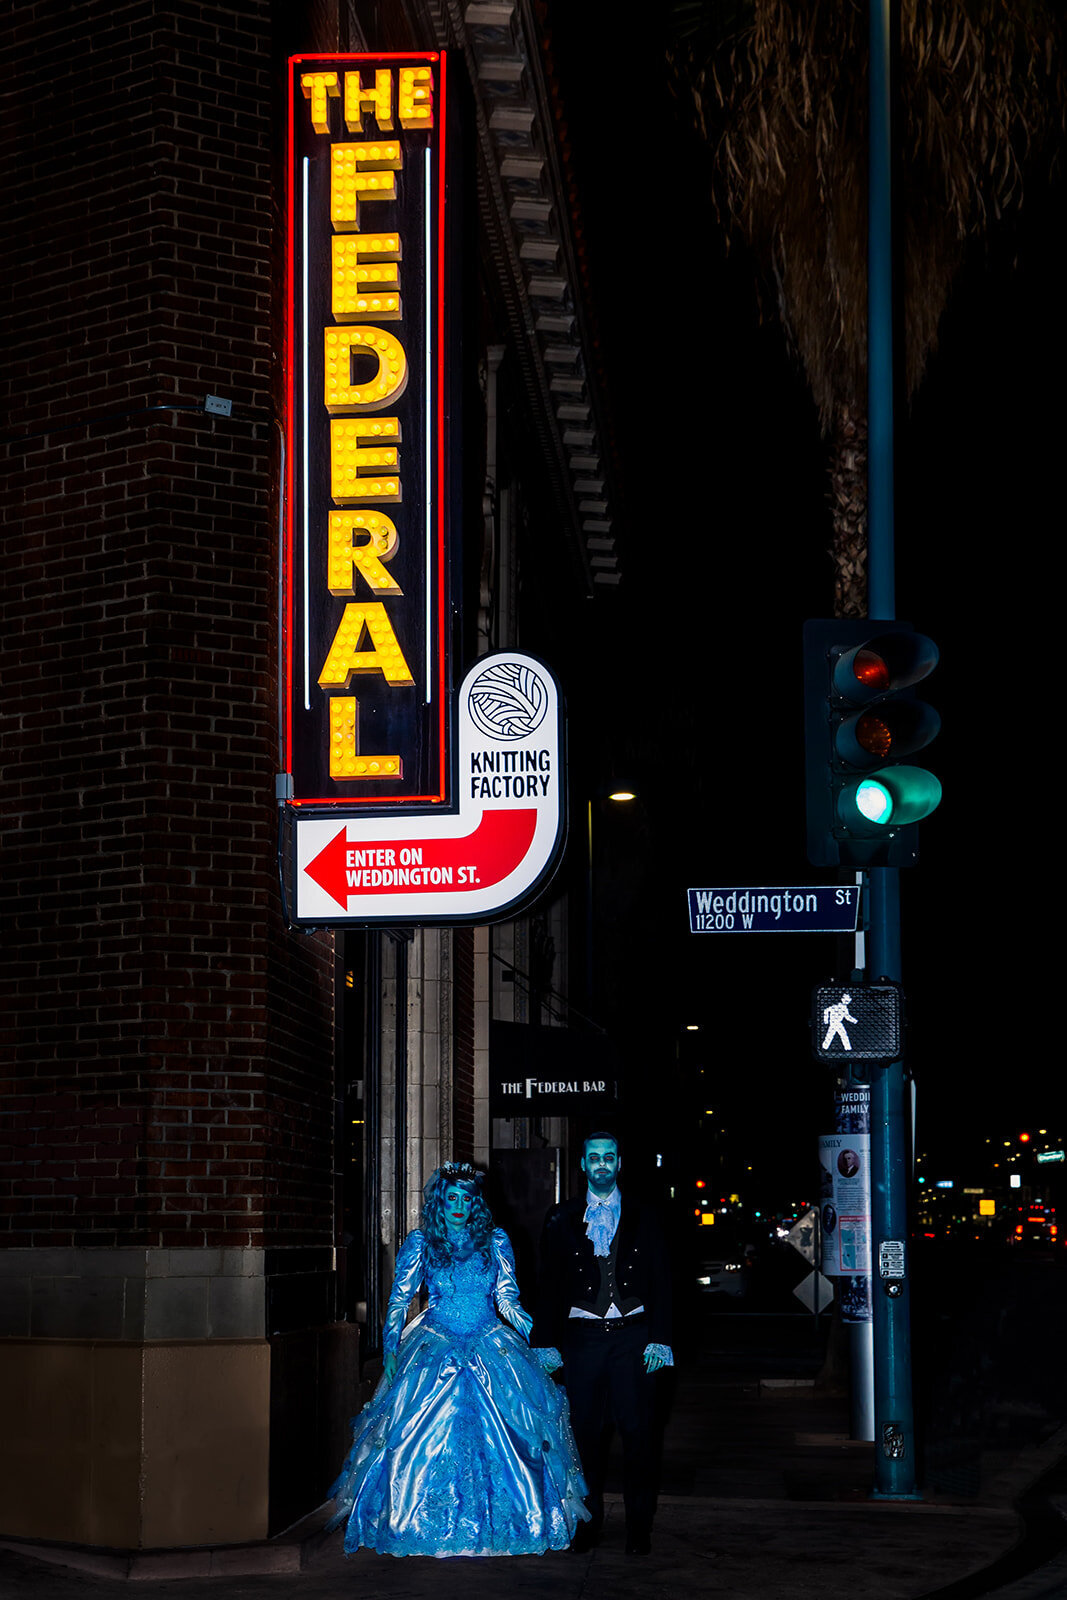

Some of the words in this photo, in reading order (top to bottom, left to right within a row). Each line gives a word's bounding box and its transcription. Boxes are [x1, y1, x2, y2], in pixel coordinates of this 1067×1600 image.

[300, 66, 434, 134] THE
[318, 140, 415, 781] FEDERAL
[470, 749, 551, 774] KNITTING
[471, 775, 551, 799] FACTORY
[346, 849, 395, 868] ENTER
[399, 848, 423, 866] ON
[346, 867, 453, 887] WEDDINGTON
[457, 866, 481, 884] ST.
[696, 890, 818, 920] Weddington
[835, 889, 852, 905] St
[696, 914, 735, 930] 11200
[742, 914, 754, 929] W
[501, 1082, 523, 1094] THE
[525, 1078, 580, 1099] FEDERAL
[583, 1080, 606, 1092] BAR
[841, 1104, 870, 1114] FAMILY
